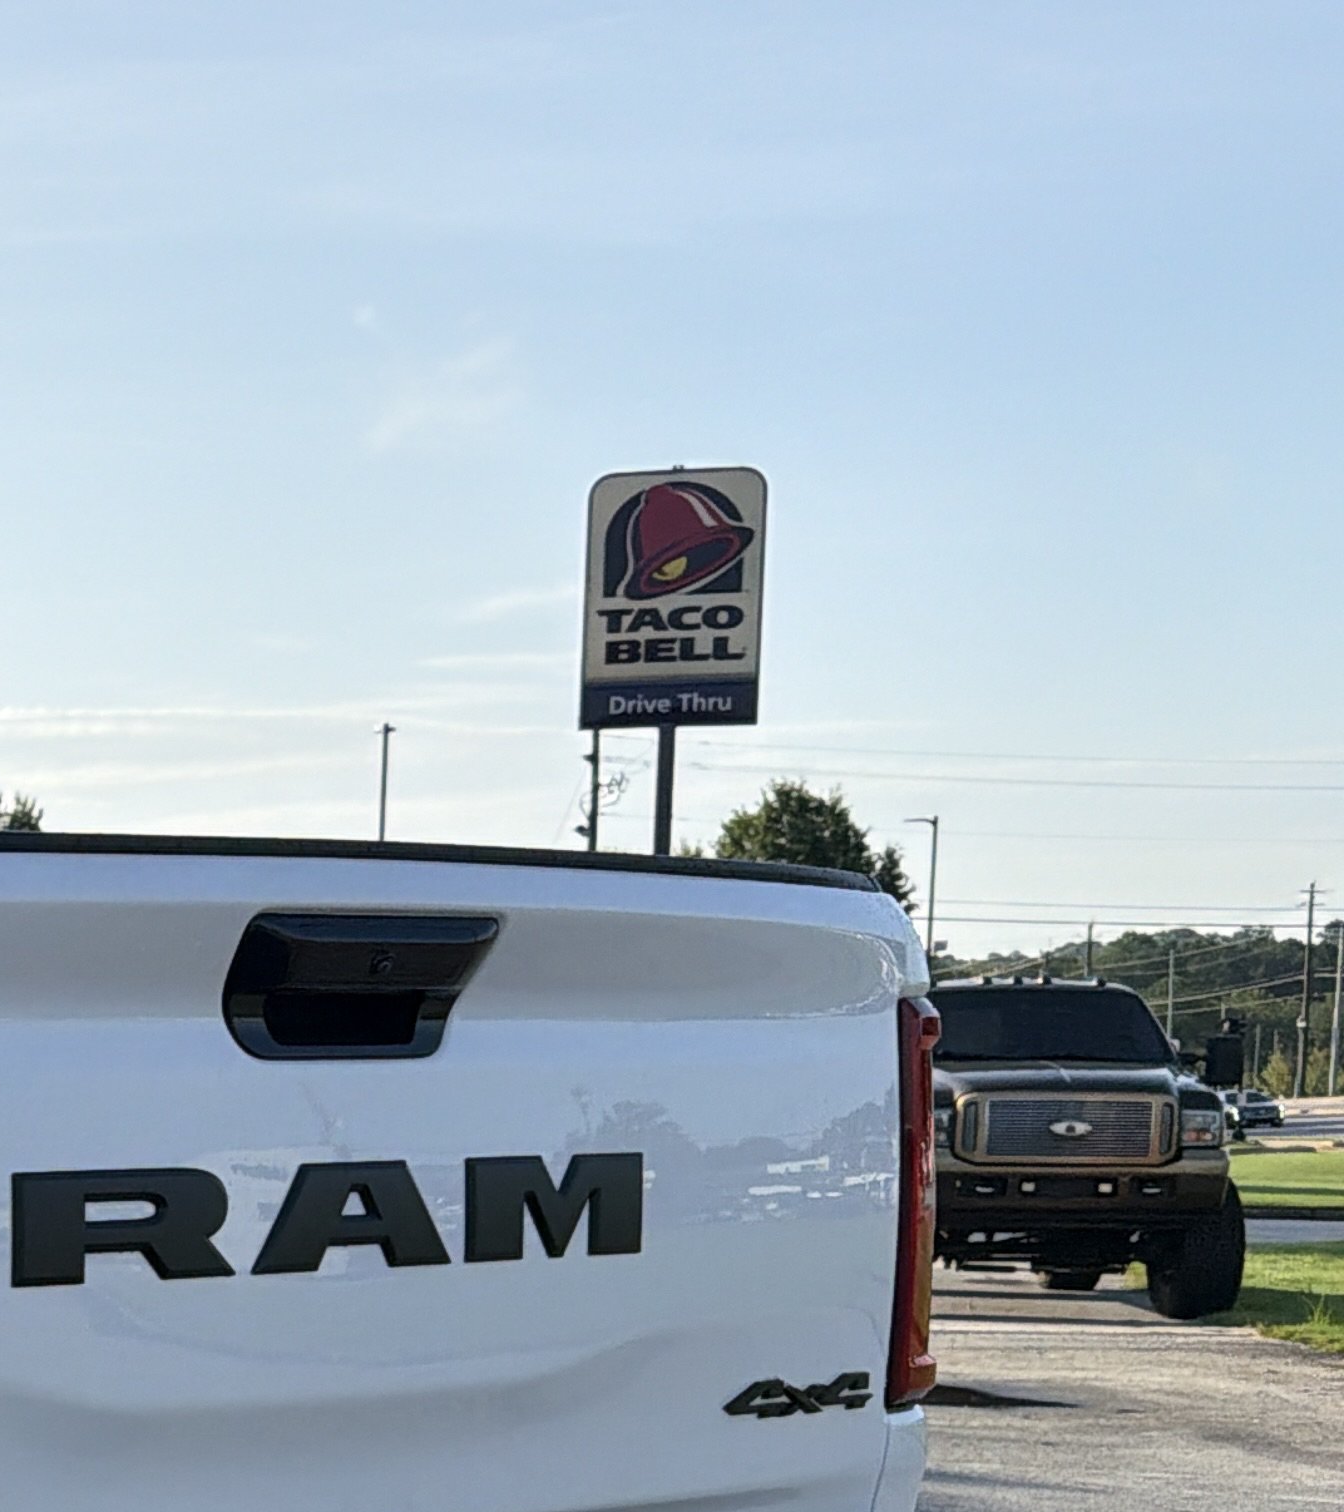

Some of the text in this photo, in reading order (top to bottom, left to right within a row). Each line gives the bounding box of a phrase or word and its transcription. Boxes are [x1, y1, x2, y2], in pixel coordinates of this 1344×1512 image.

[597, 605, 744, 634] TACO
[605, 636, 746, 665] BELL
[609, 692, 733, 715] Drive Thru
[11, 1152, 644, 1288] RAM
